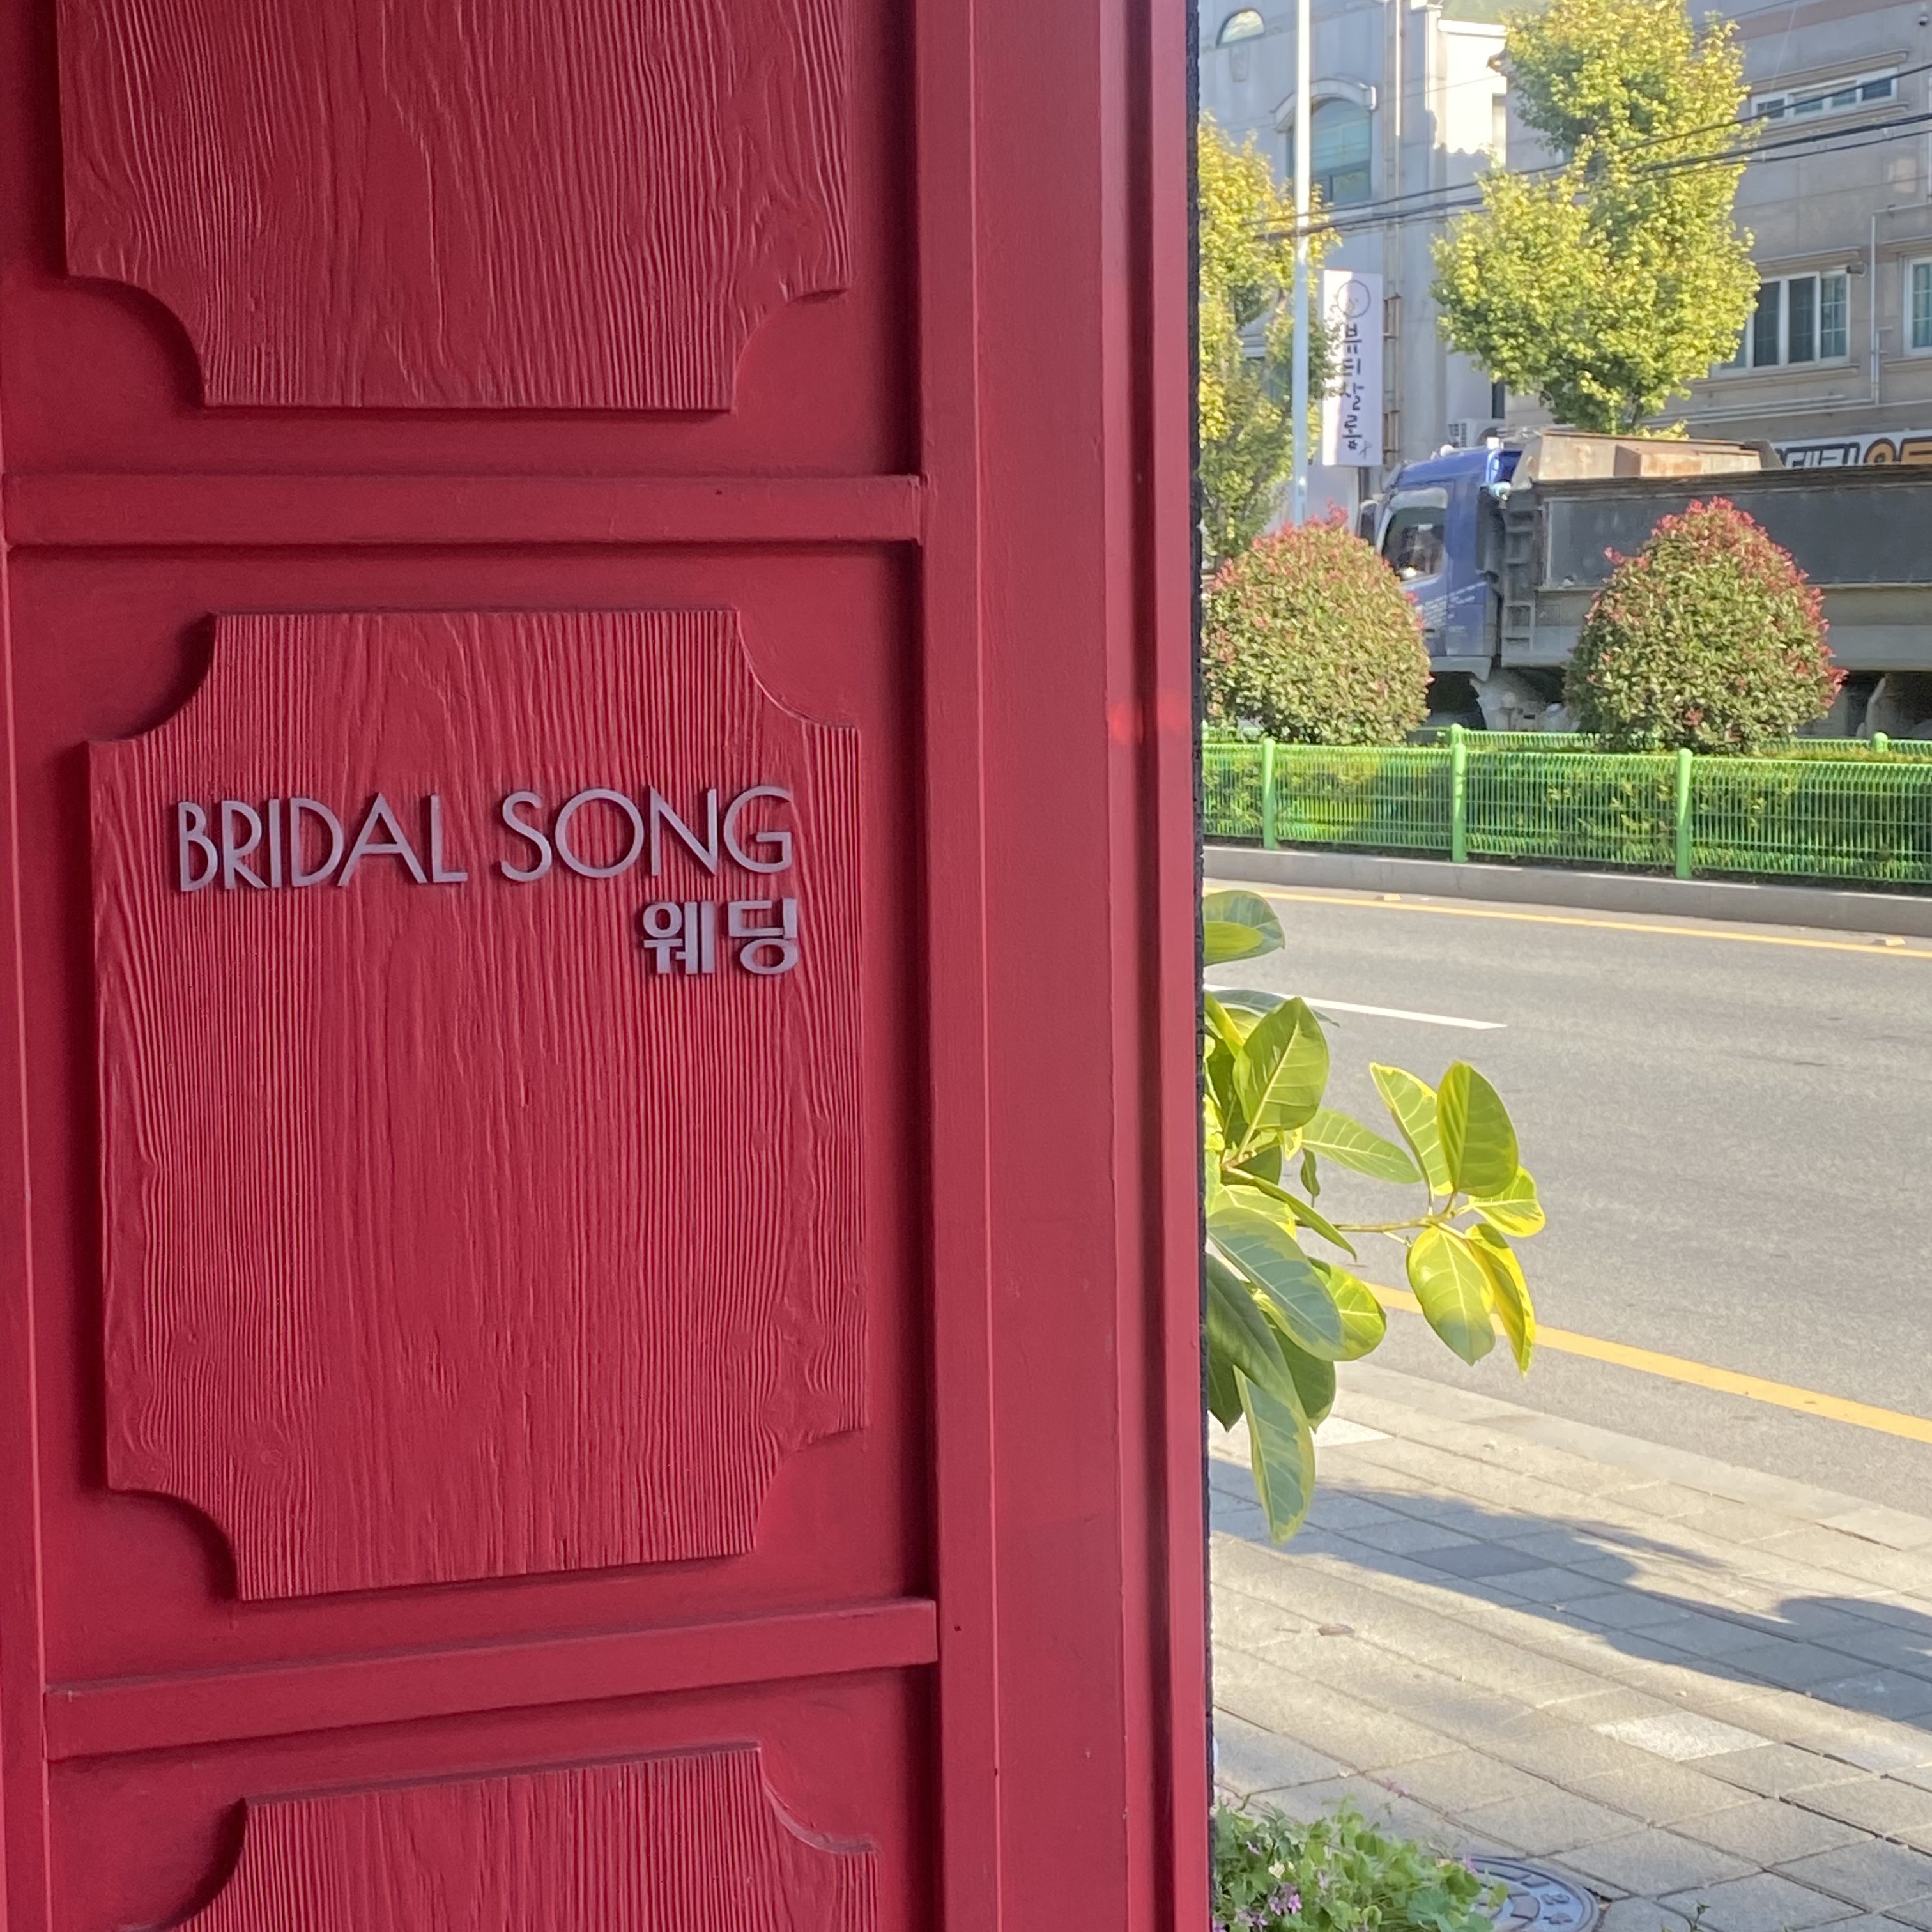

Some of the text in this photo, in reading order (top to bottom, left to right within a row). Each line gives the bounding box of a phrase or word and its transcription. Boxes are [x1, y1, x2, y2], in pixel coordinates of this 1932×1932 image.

[177, 784, 794, 893] BRIDAL SONG
[642, 896, 799, 975] 웨딩
